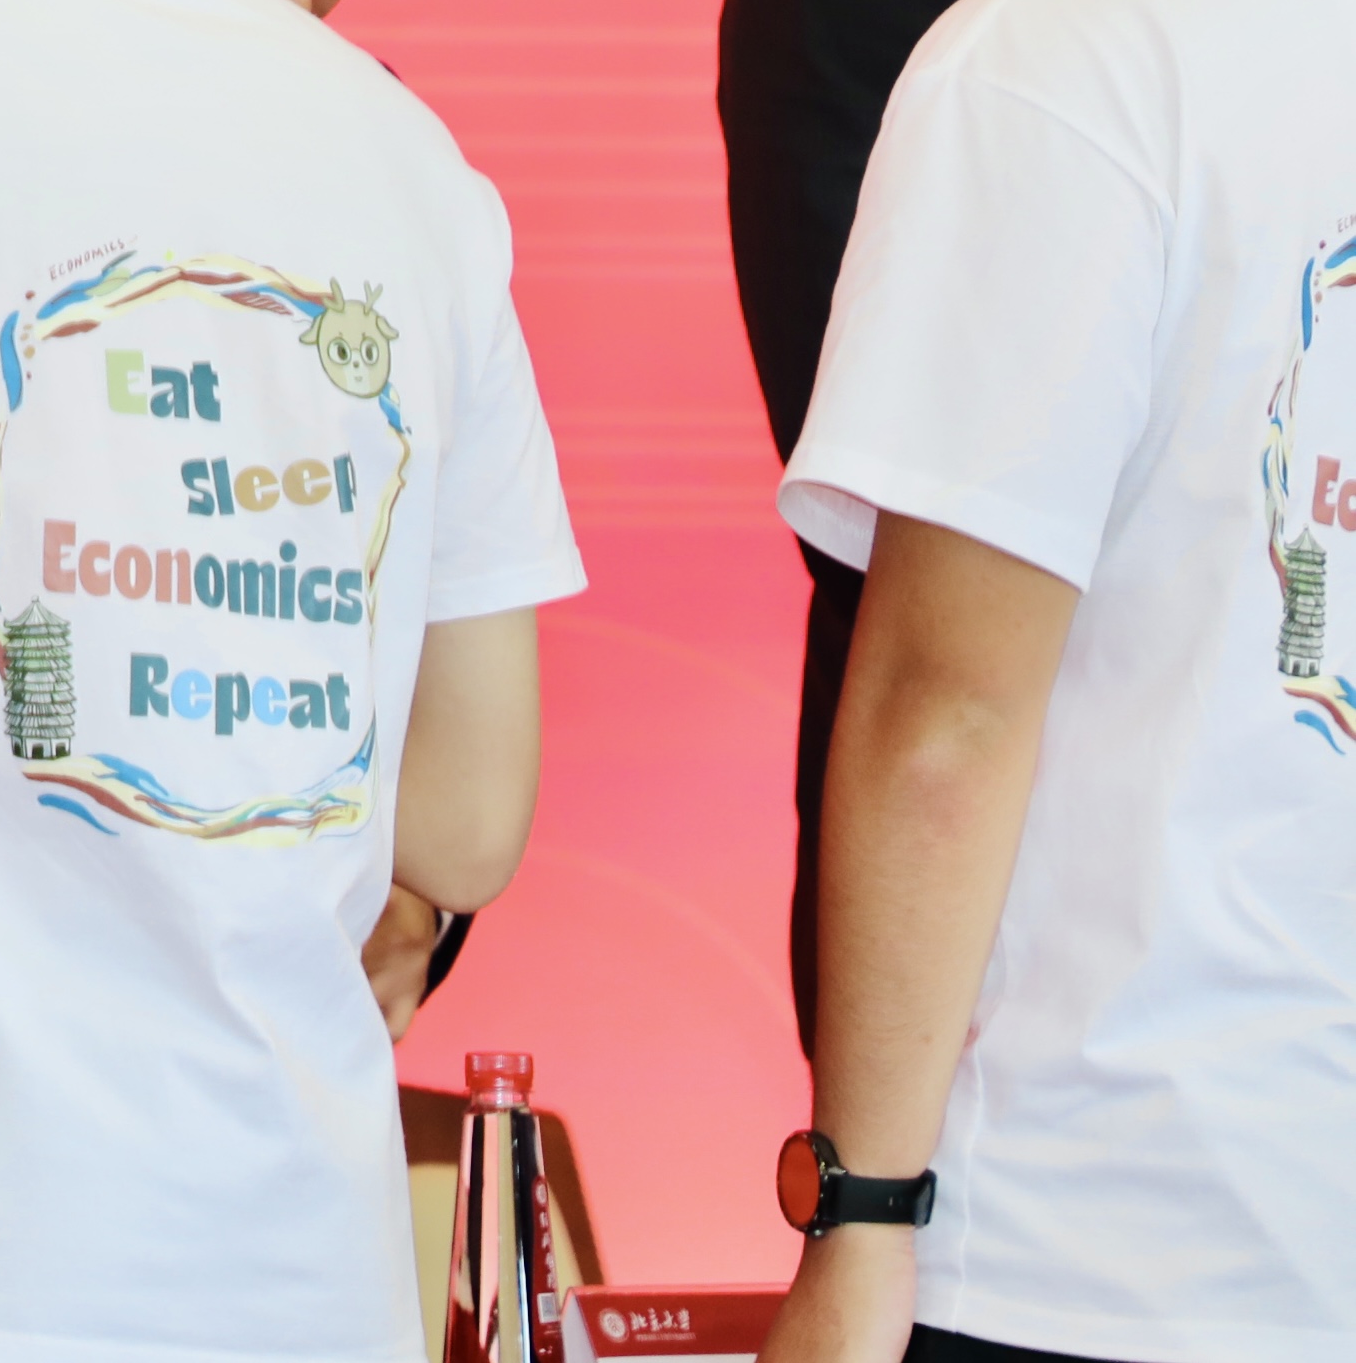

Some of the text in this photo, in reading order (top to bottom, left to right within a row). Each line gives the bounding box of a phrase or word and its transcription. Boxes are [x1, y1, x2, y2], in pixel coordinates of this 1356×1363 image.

[104, 348, 221, 421] Eat
[42, 519, 363, 625] Economics
[129, 652, 350, 736] Repeat
